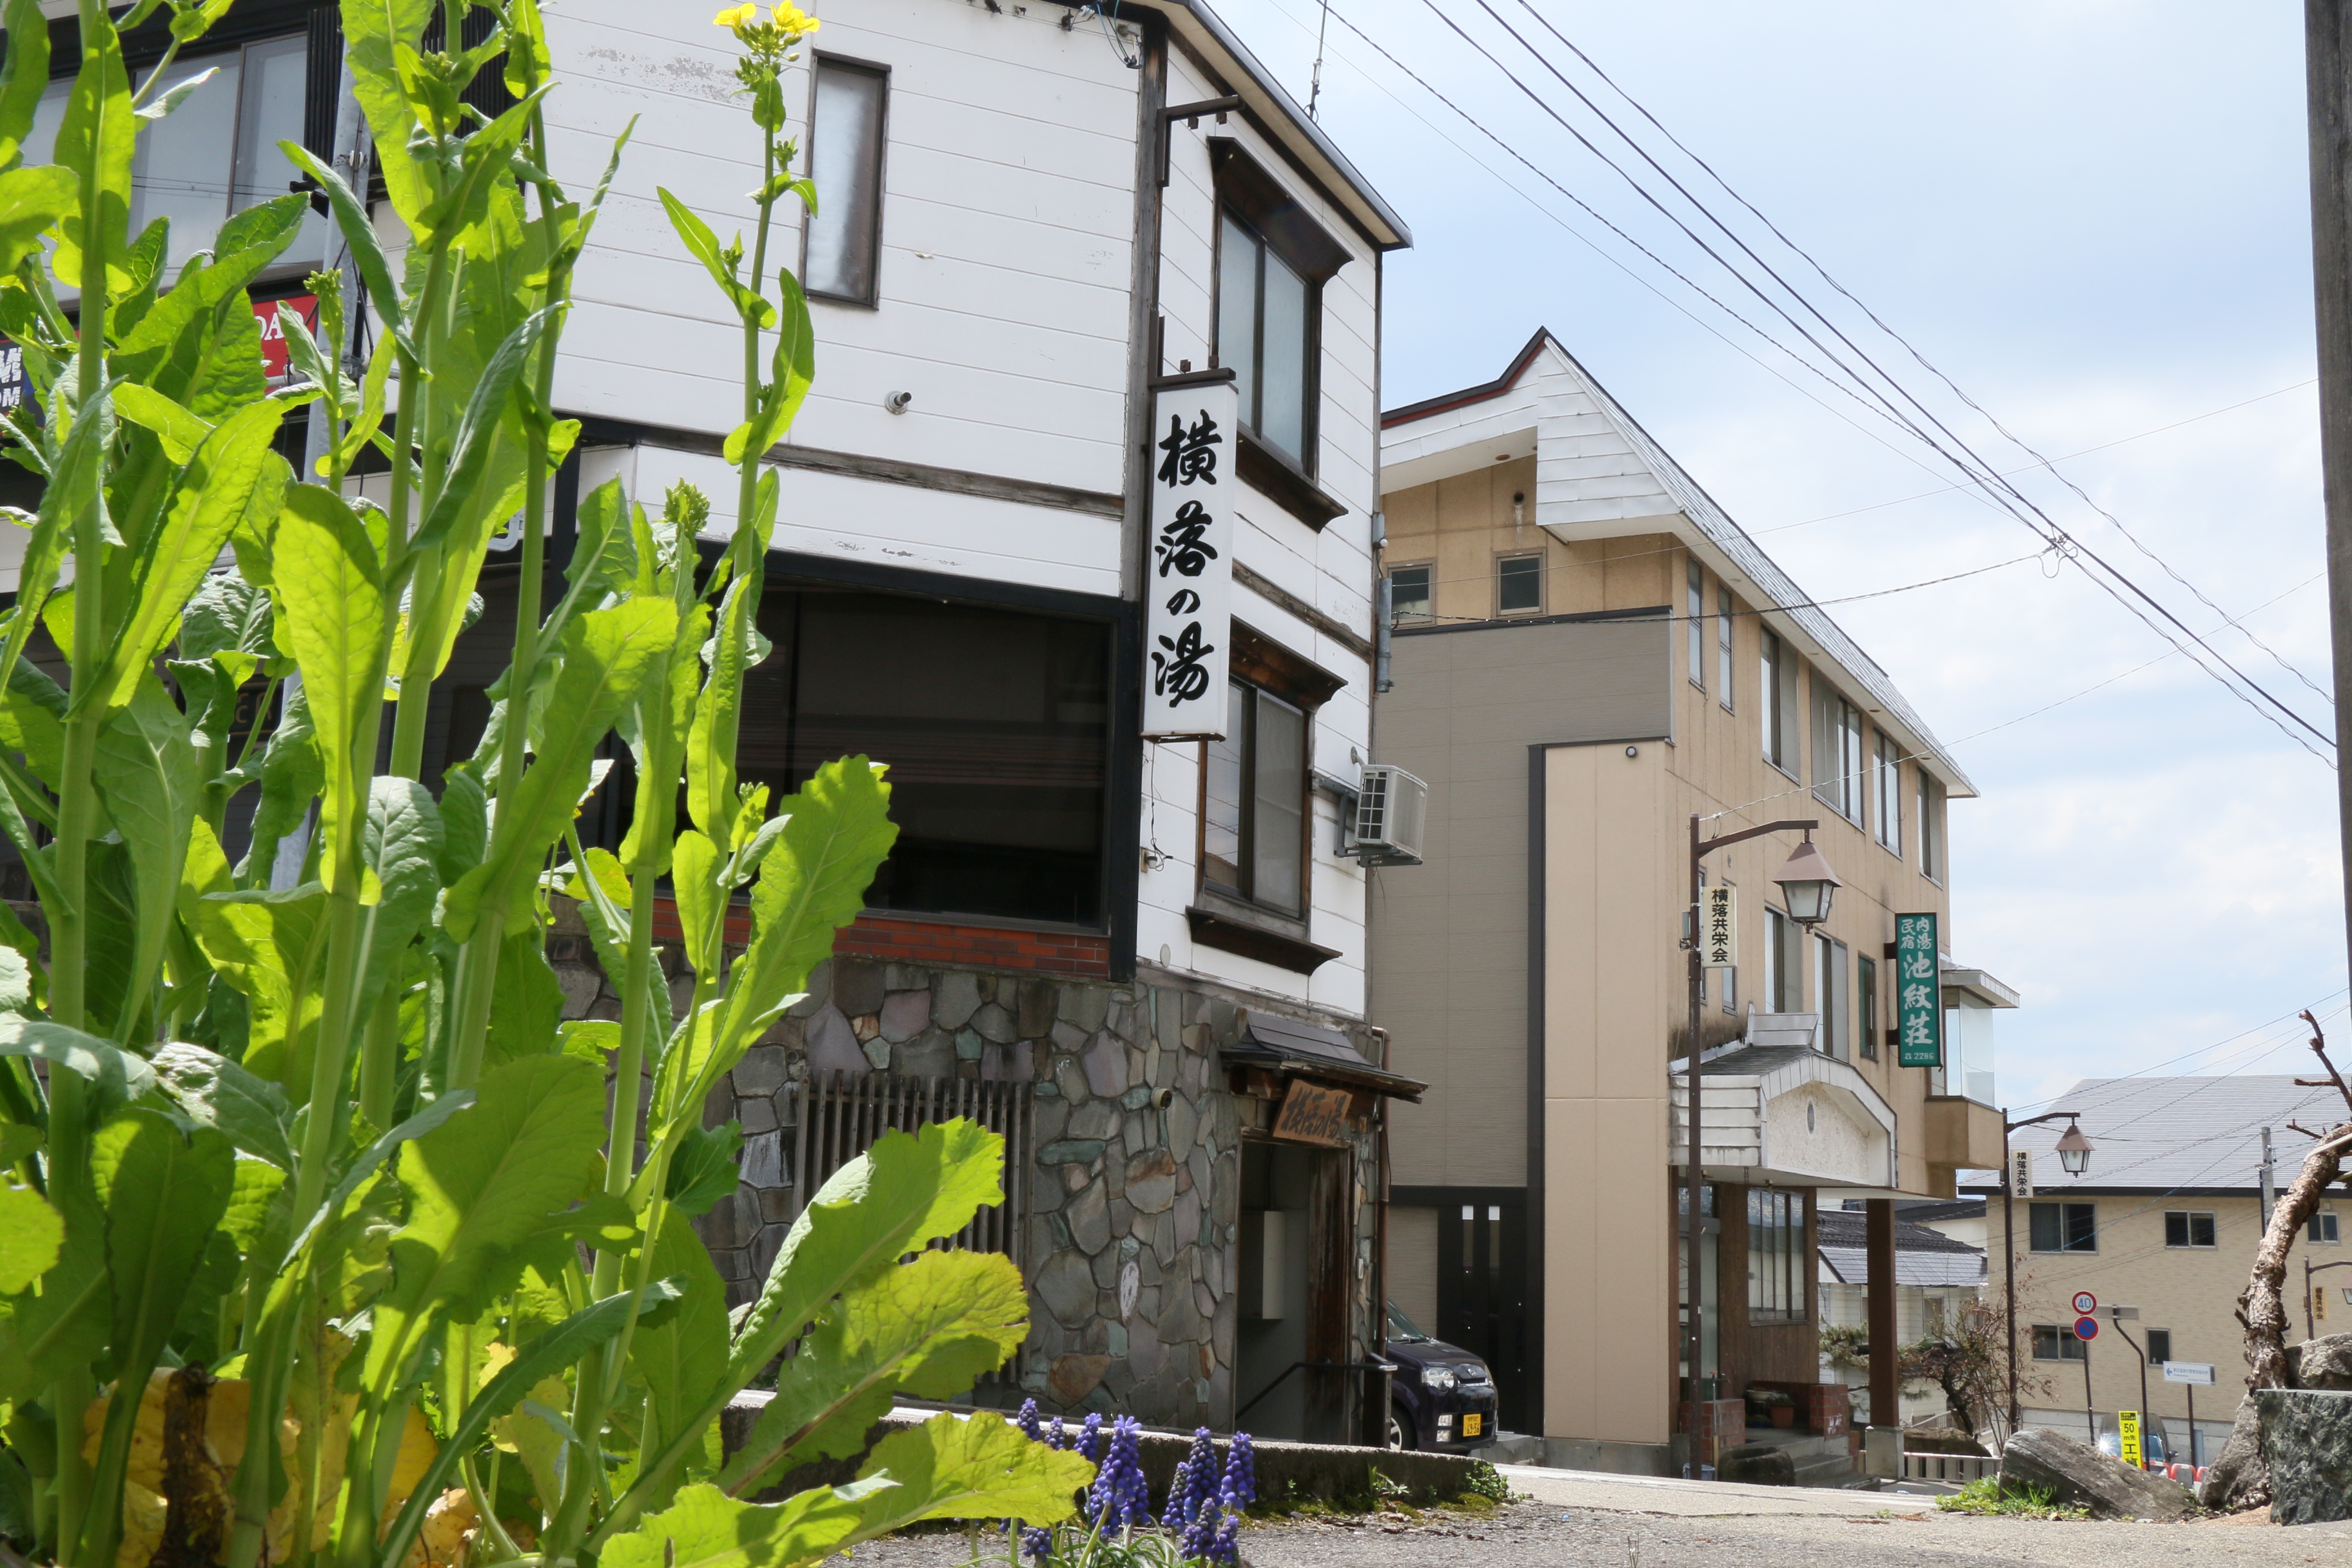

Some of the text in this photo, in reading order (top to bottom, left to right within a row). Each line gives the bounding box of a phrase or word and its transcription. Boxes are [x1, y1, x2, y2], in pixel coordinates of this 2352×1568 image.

[1151, 408, 1222, 708] 横落の湯
[1712, 888, 1728, 962] 横落共栄会
[1901, 919, 1916, 949] 民宿
[1916, 917, 1932, 950] 内湯
[1903, 951, 1934, 1046] 池紋荘
[2016, 1152, 2027, 1196] 横落共栄会
[2077, 1298, 2092, 1308] 40
[2124, 1423, 2135, 1433] 50
